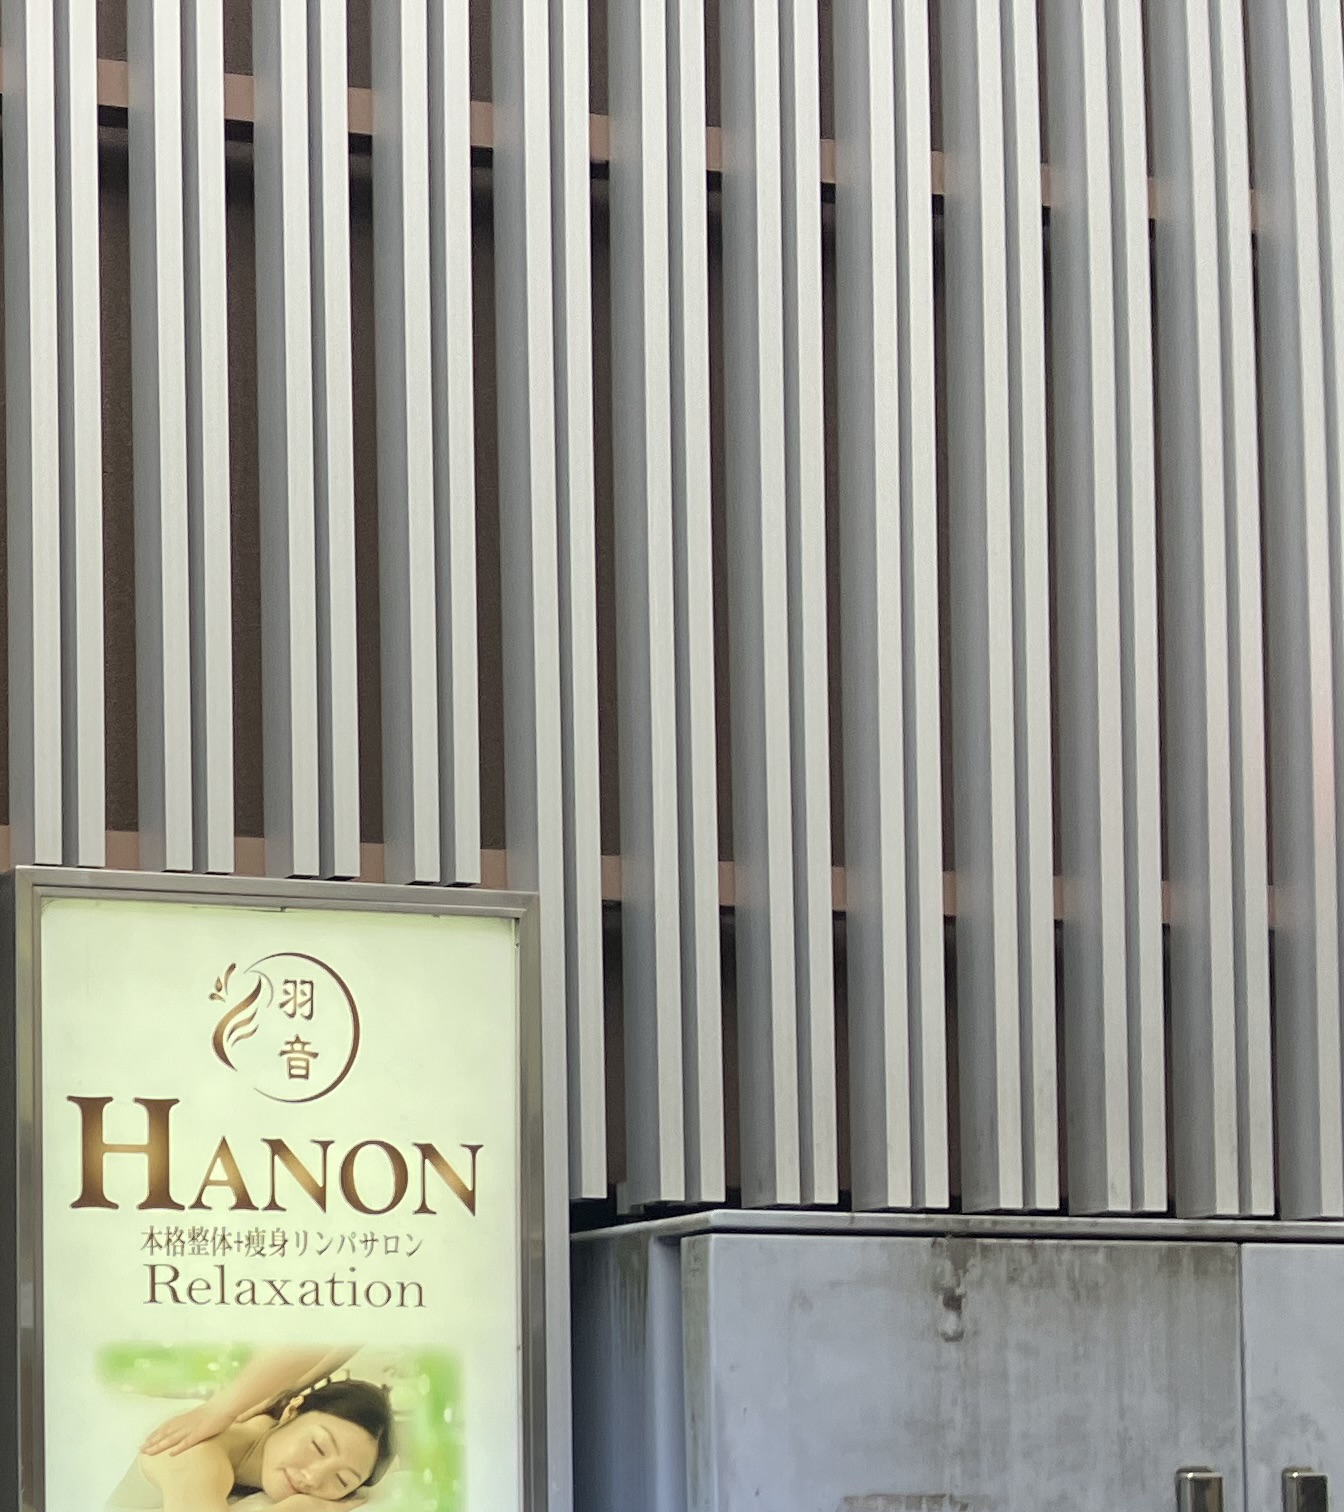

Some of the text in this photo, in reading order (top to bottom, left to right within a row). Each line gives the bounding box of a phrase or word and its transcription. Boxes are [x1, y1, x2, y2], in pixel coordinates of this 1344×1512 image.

[278, 978, 318, 1080] 羽音
[67, 1095, 484, 1217] HANON
[143, 1263, 426, 1309] Relaxation
